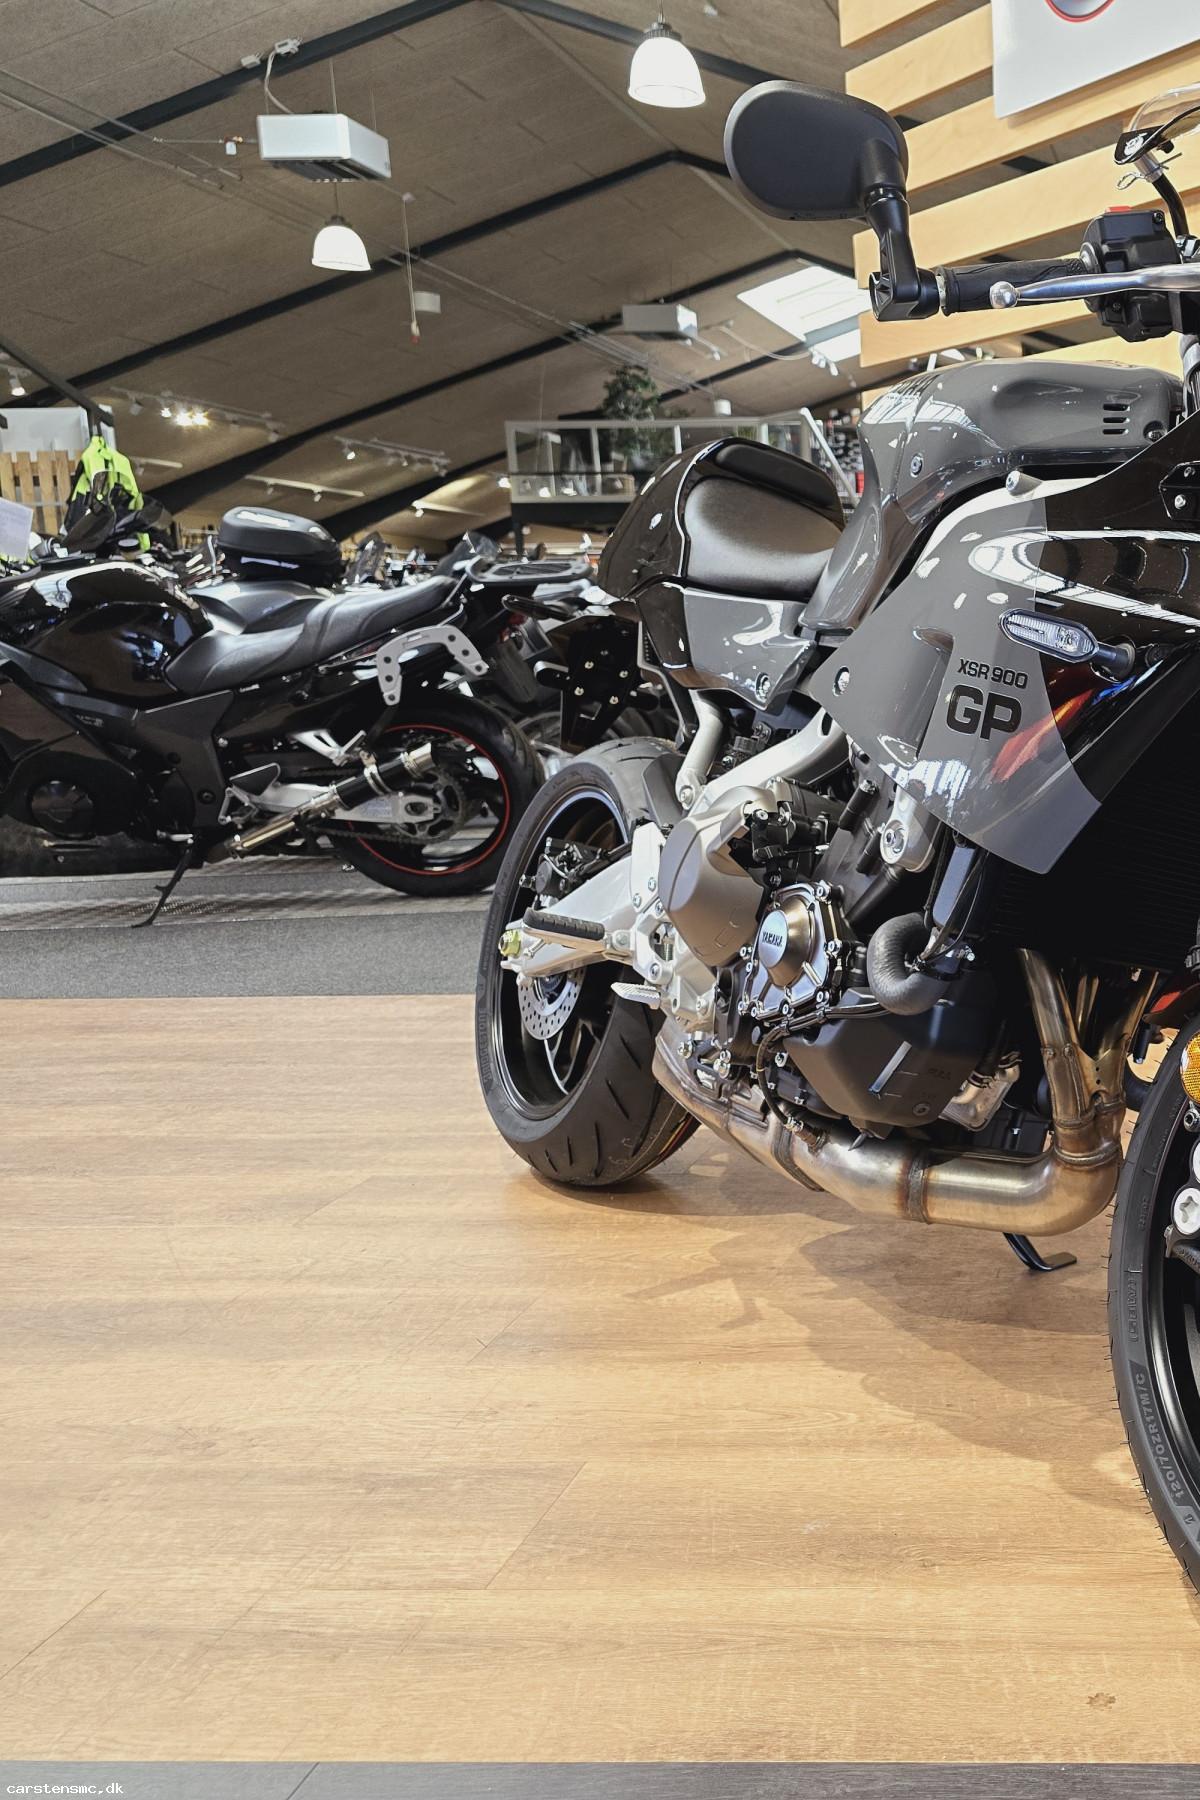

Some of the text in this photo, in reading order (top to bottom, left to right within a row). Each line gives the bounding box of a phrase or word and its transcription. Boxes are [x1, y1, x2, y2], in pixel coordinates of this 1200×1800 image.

[958, 658, 1028, 689] XSR 900
[946, 684, 1022, 740] GP
